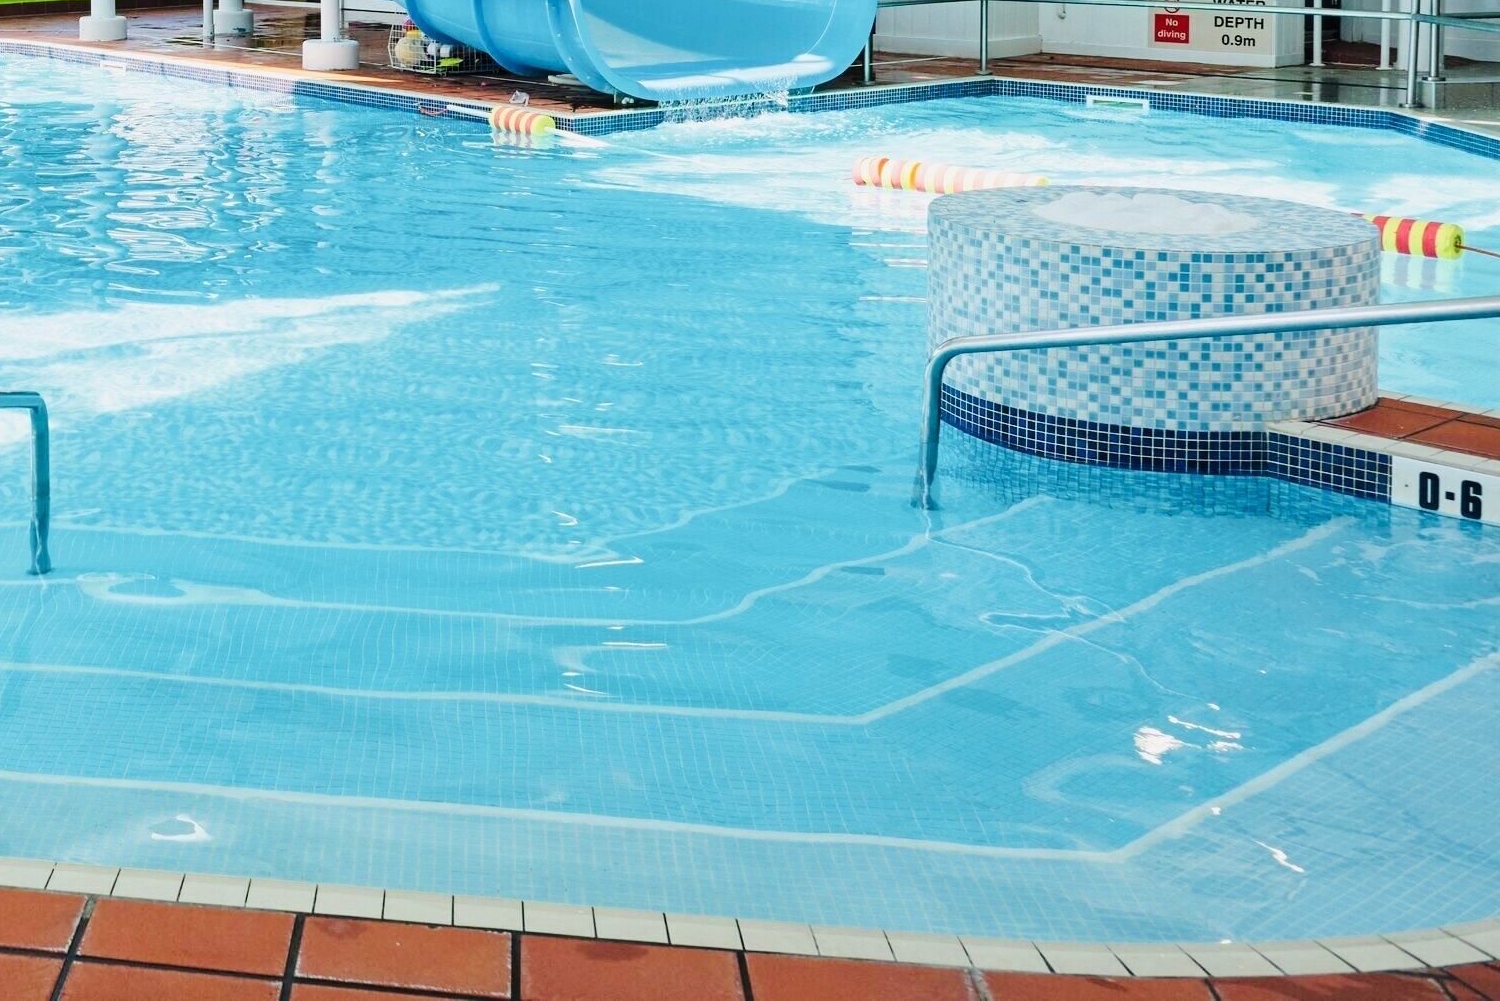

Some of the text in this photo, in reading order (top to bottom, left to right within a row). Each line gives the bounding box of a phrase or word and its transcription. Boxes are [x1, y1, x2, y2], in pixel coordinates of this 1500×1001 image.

[1165, 18, 1178, 27] No
[1214, 16, 1264, 29] DEPTH
[1158, 30, 1186, 40] diving
[1222, 34, 1256, 47] 0.9m
[1418, 471, 1483, 520] 0-6
